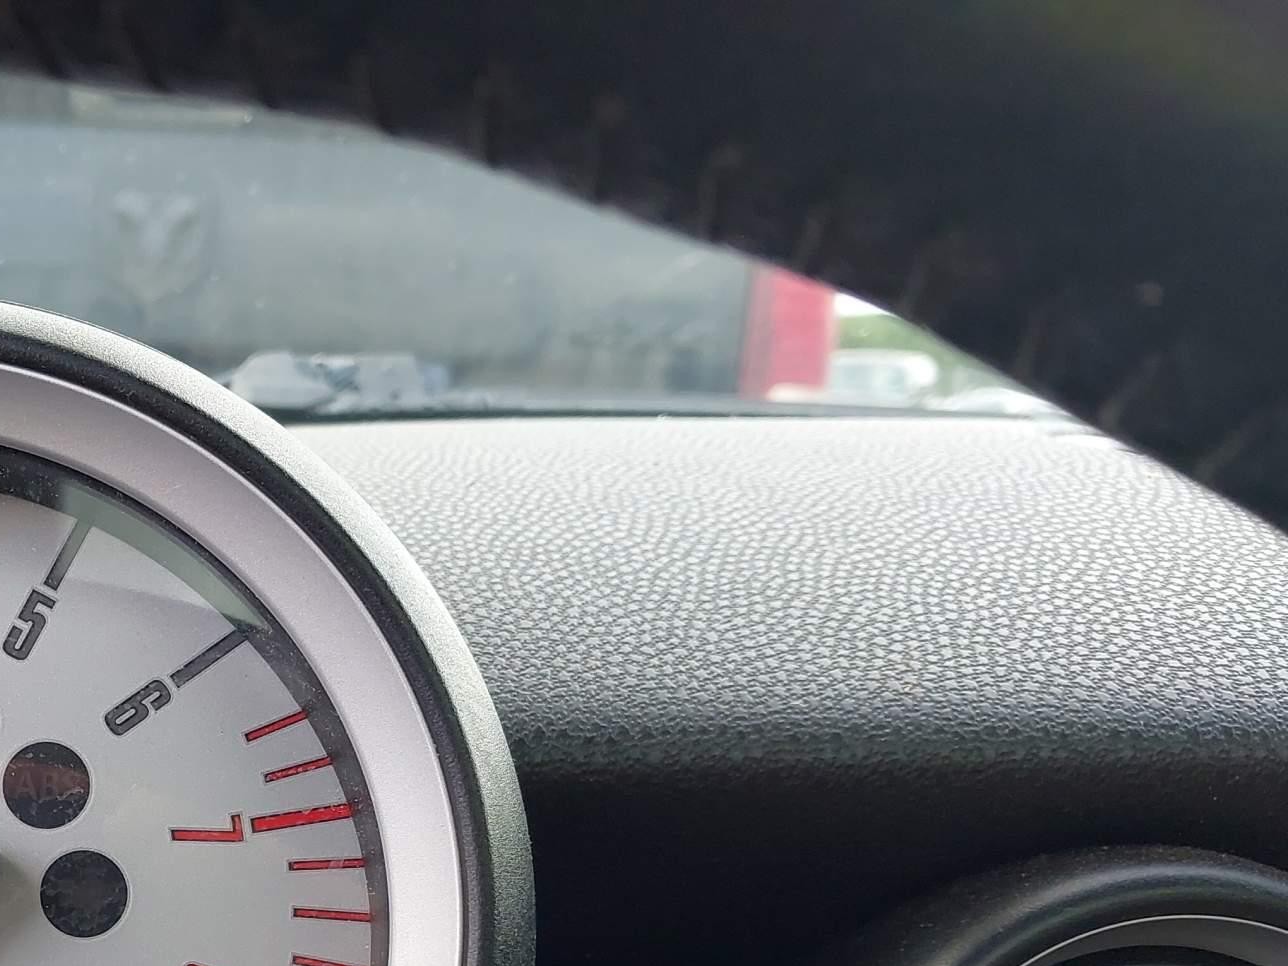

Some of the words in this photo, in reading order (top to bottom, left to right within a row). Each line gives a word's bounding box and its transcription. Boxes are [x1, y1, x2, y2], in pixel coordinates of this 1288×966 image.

[2, 591, 55, 660] 5
[104, 679, 171, 735] 6
[170, 814, 244, 842] 7
